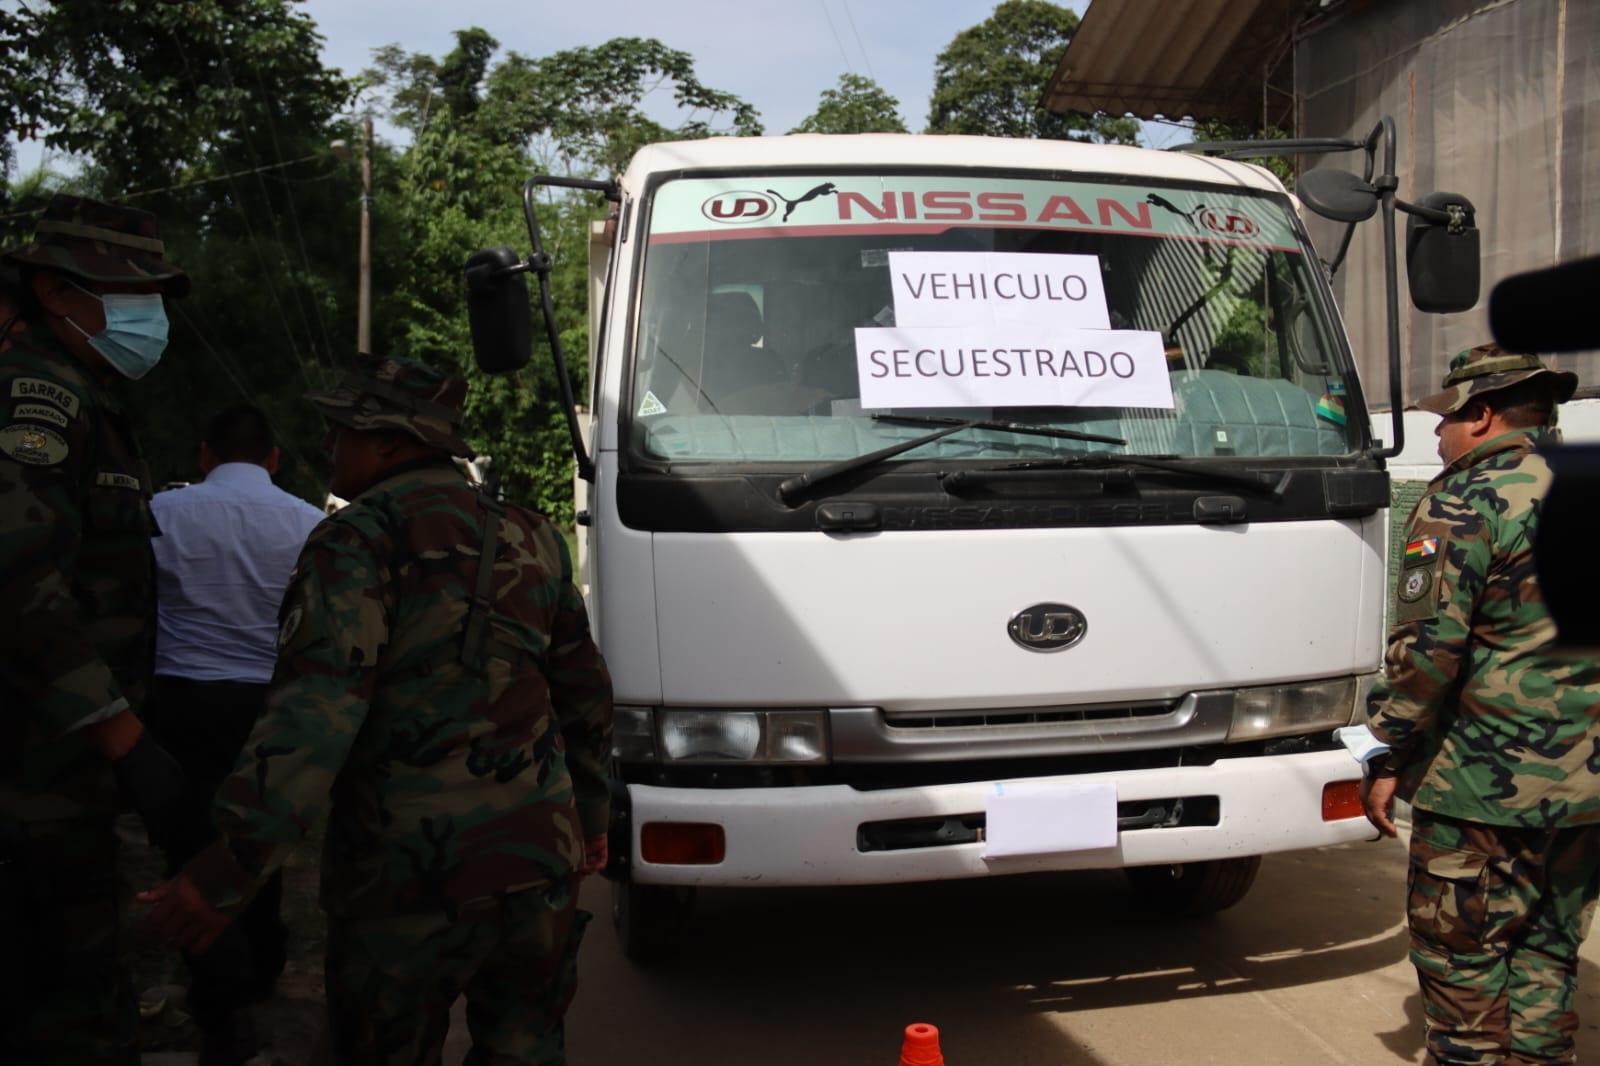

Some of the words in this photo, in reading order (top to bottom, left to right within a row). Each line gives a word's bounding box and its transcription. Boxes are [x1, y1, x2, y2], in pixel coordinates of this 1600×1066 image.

[836, 190, 1153, 230] NISSAN
[902, 273, 1087, 301] VEHICULO
[870, 349, 1135, 379] SECUESTRADO
[19, 382, 73, 409] GARRAS
[1018, 612, 1080, 641] UD
